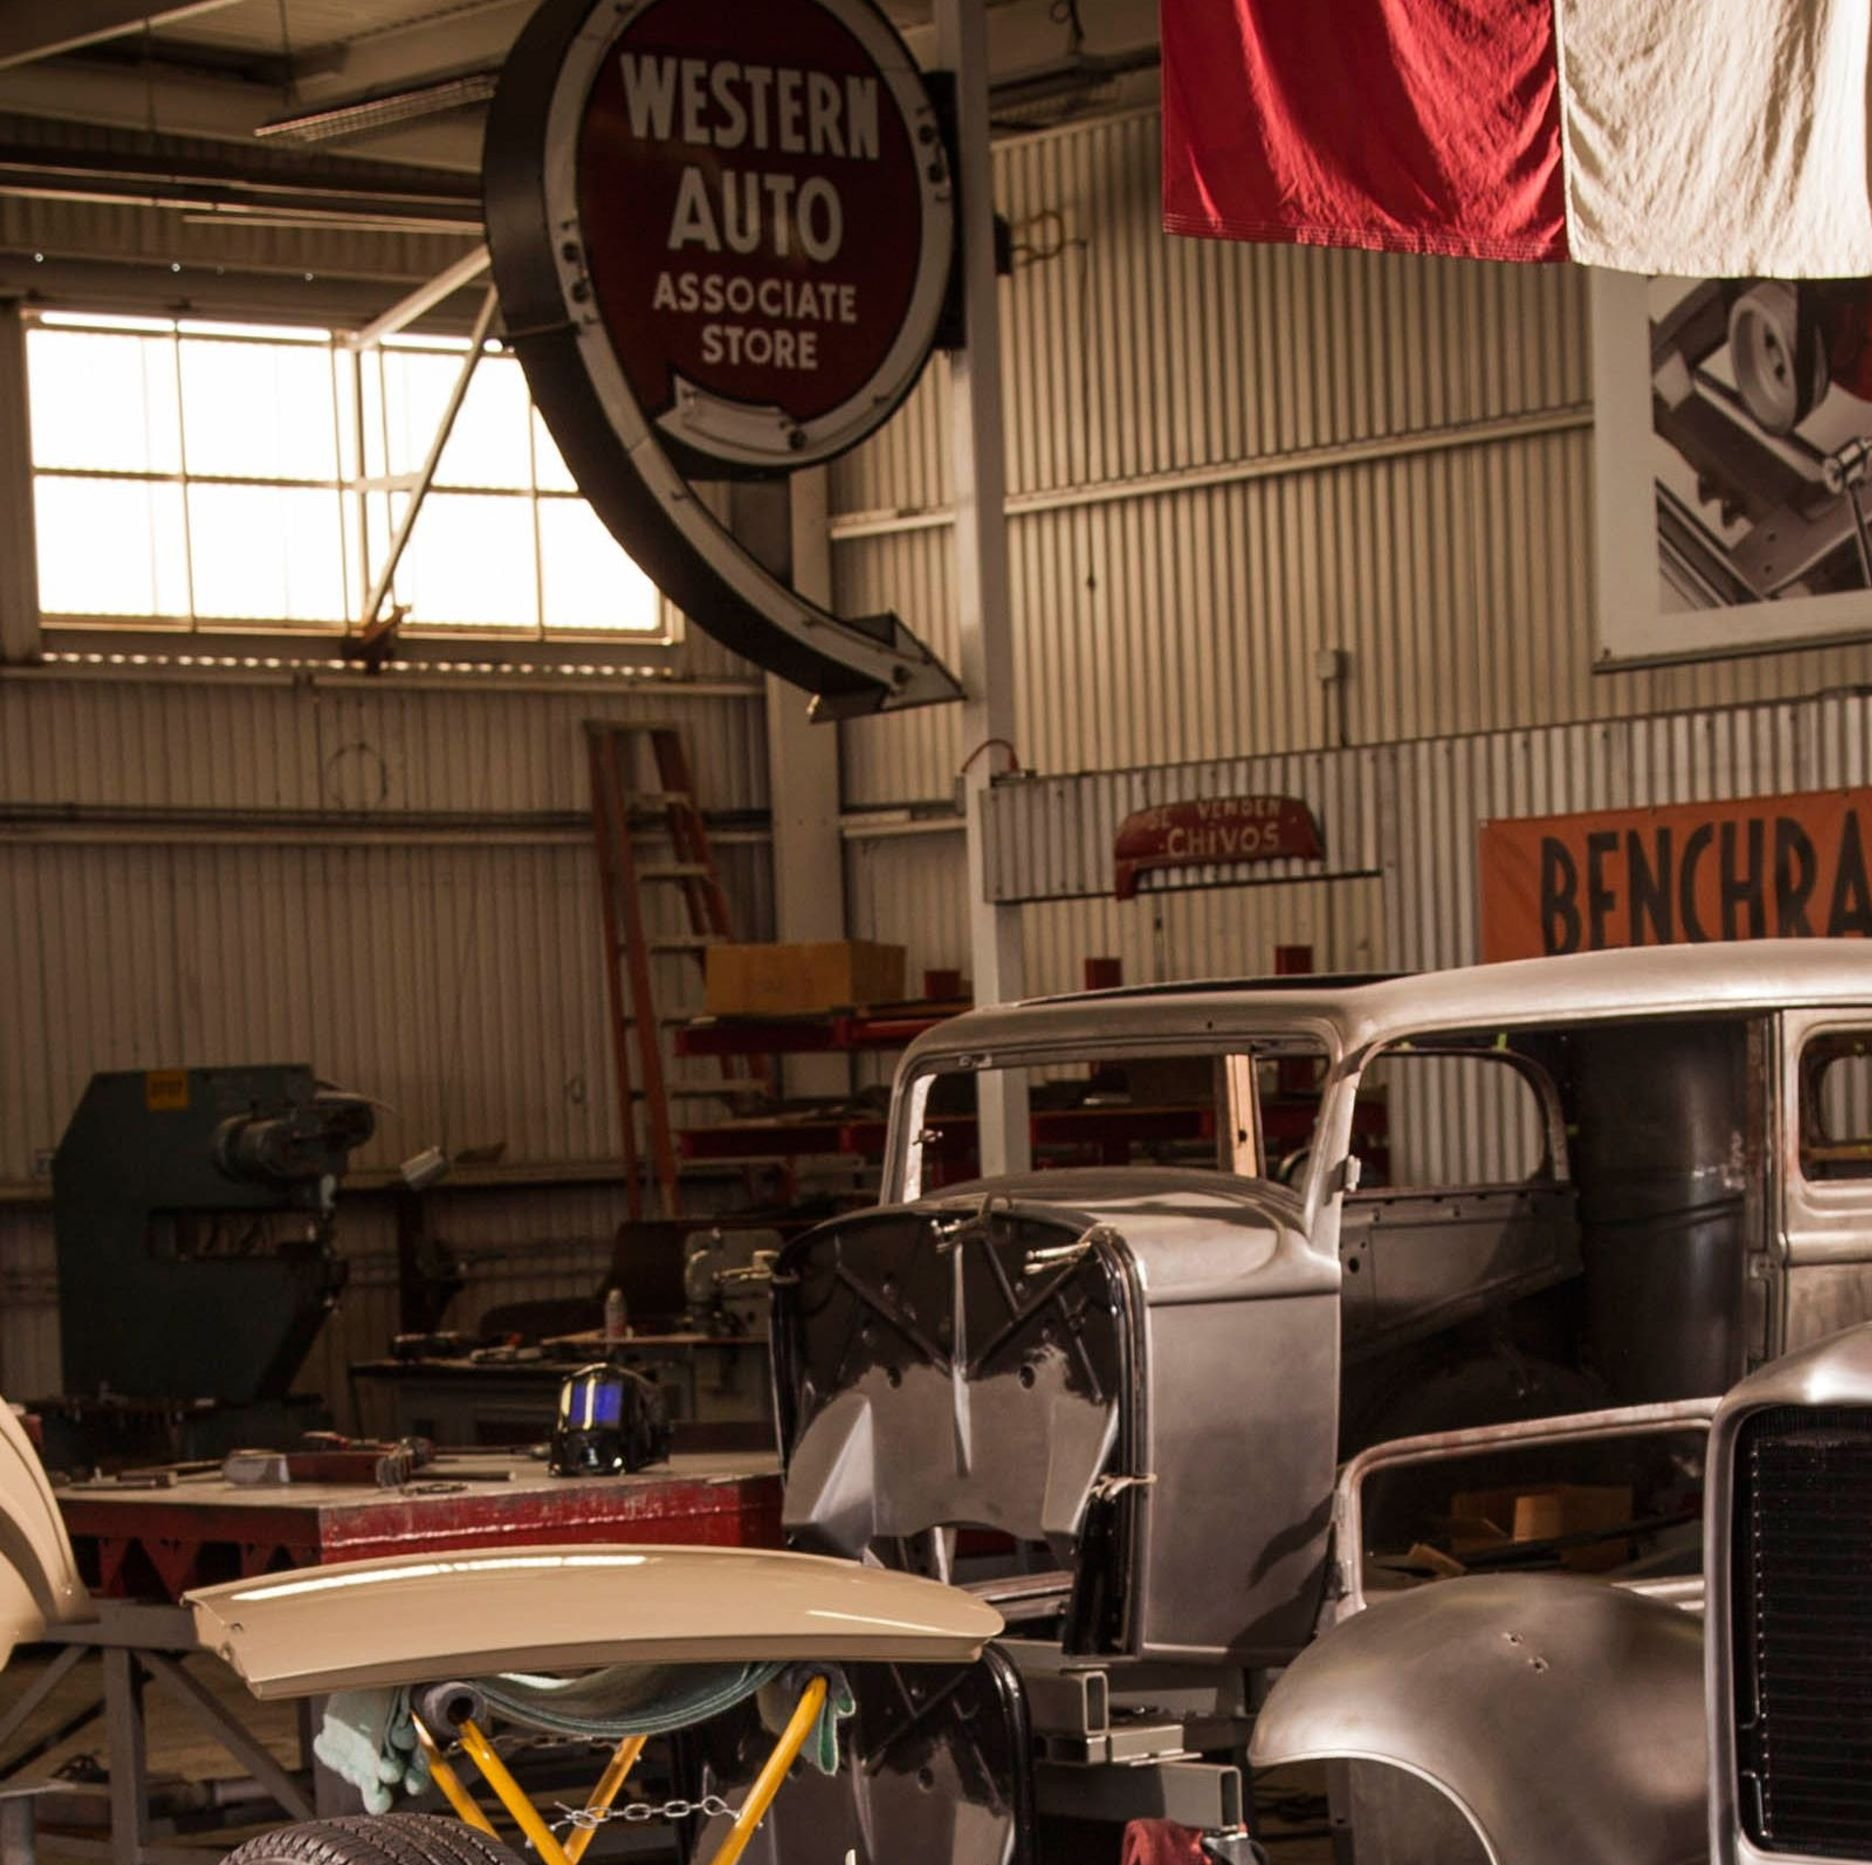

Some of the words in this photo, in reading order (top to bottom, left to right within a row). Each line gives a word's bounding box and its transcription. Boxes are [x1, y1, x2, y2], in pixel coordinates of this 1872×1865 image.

[620, 53, 880, 161] WESTERN
[667, 166, 843, 263] AUTO
[653, 272, 858, 324] ASSOCIATE
[700, 325, 819, 370] STORE
